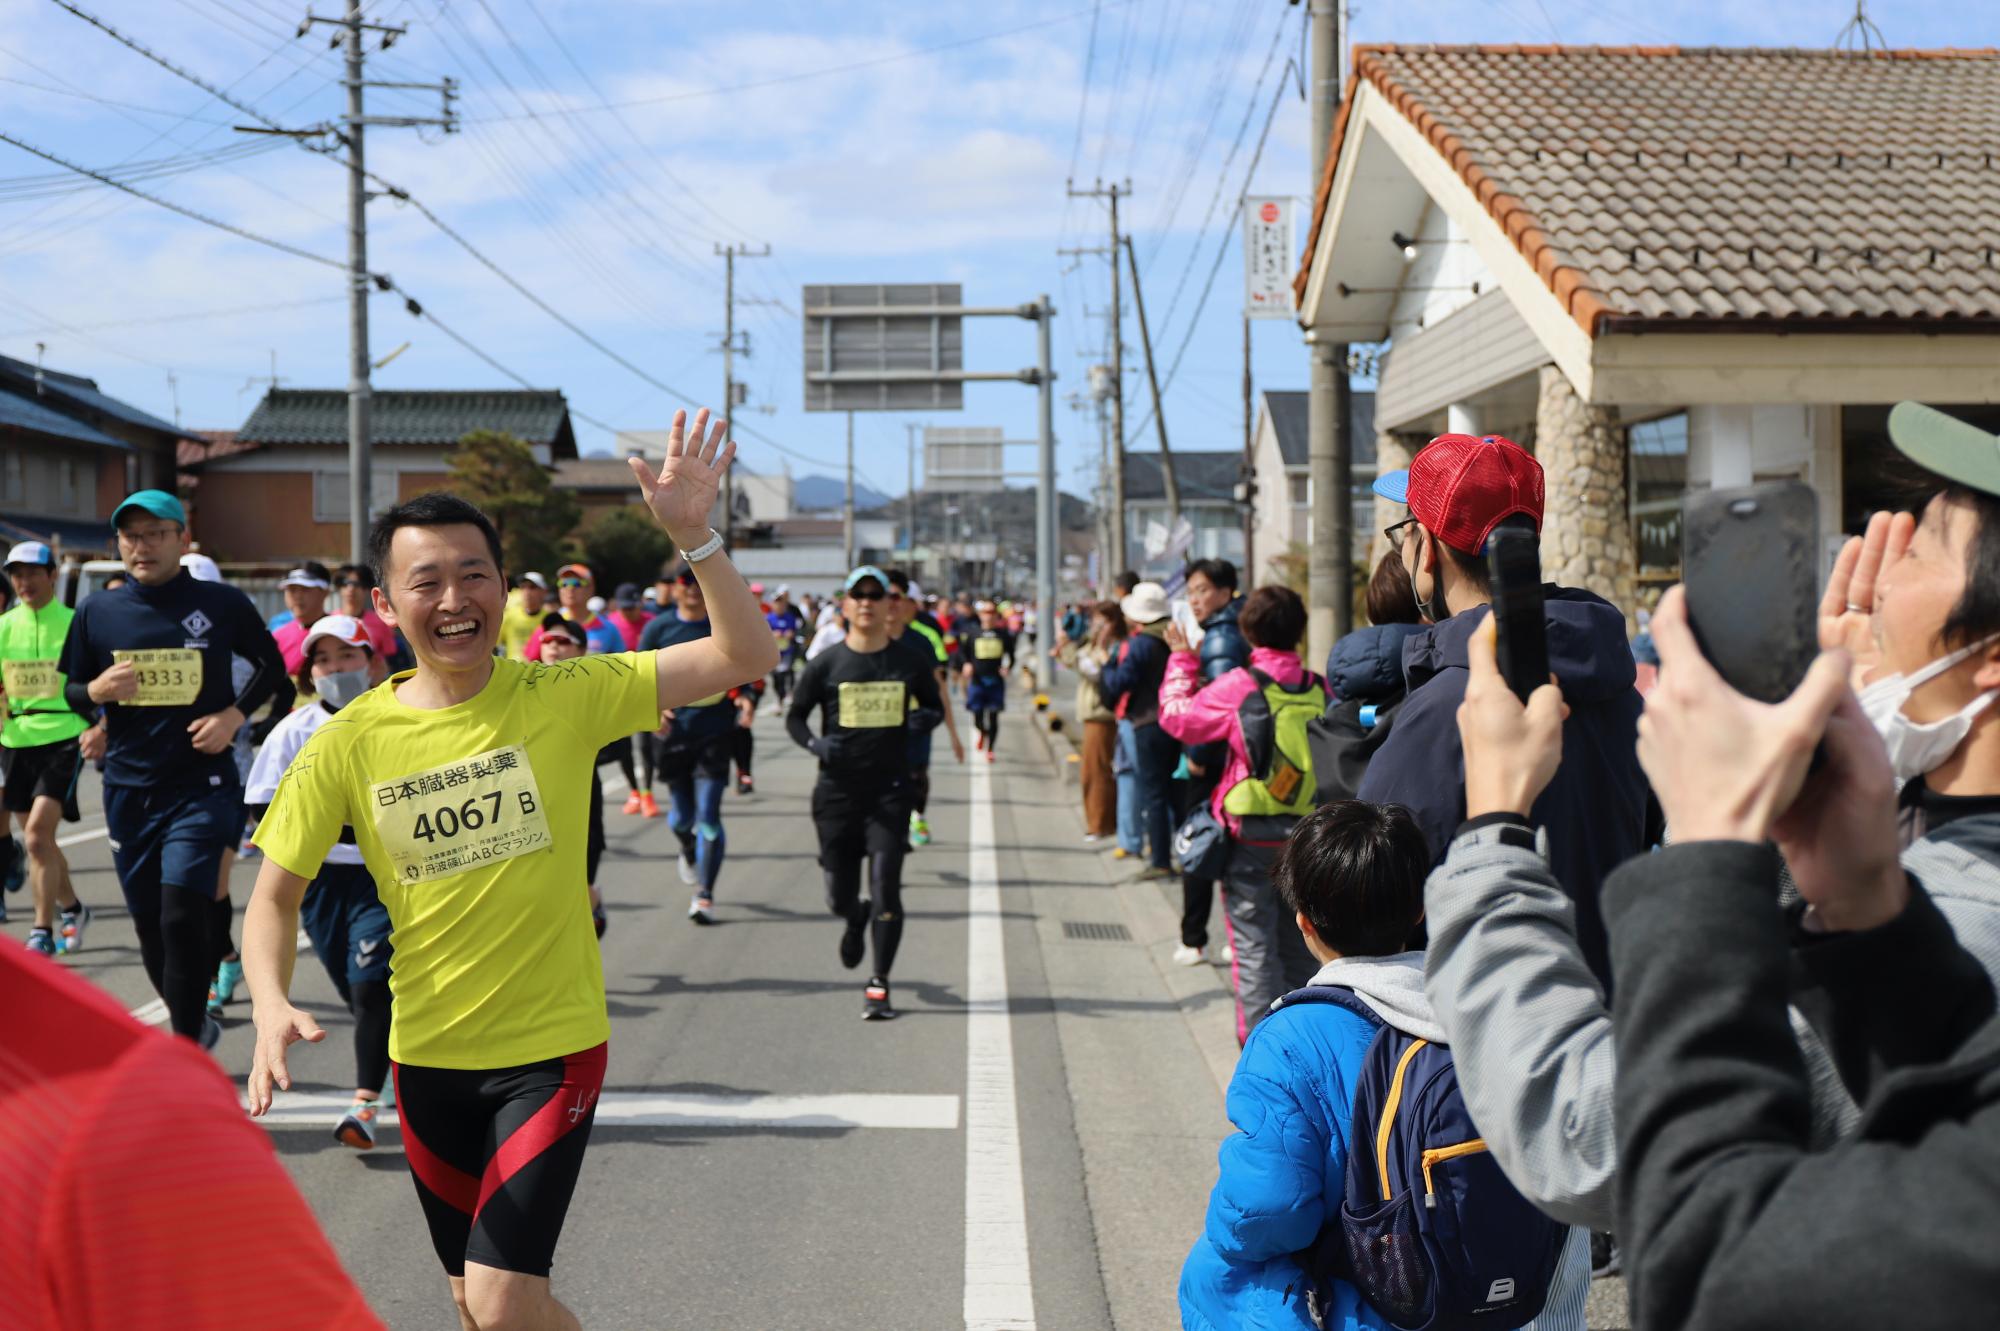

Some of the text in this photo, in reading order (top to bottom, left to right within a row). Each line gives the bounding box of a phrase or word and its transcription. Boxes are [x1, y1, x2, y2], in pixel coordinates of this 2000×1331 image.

[136, 669, 199, 686] 4333 C
[377, 751, 519, 807] 日本臓器製薬
[412, 790, 536, 843] 4067 B
[425, 831, 544, 875] 丹波篠山ABCマラソン
